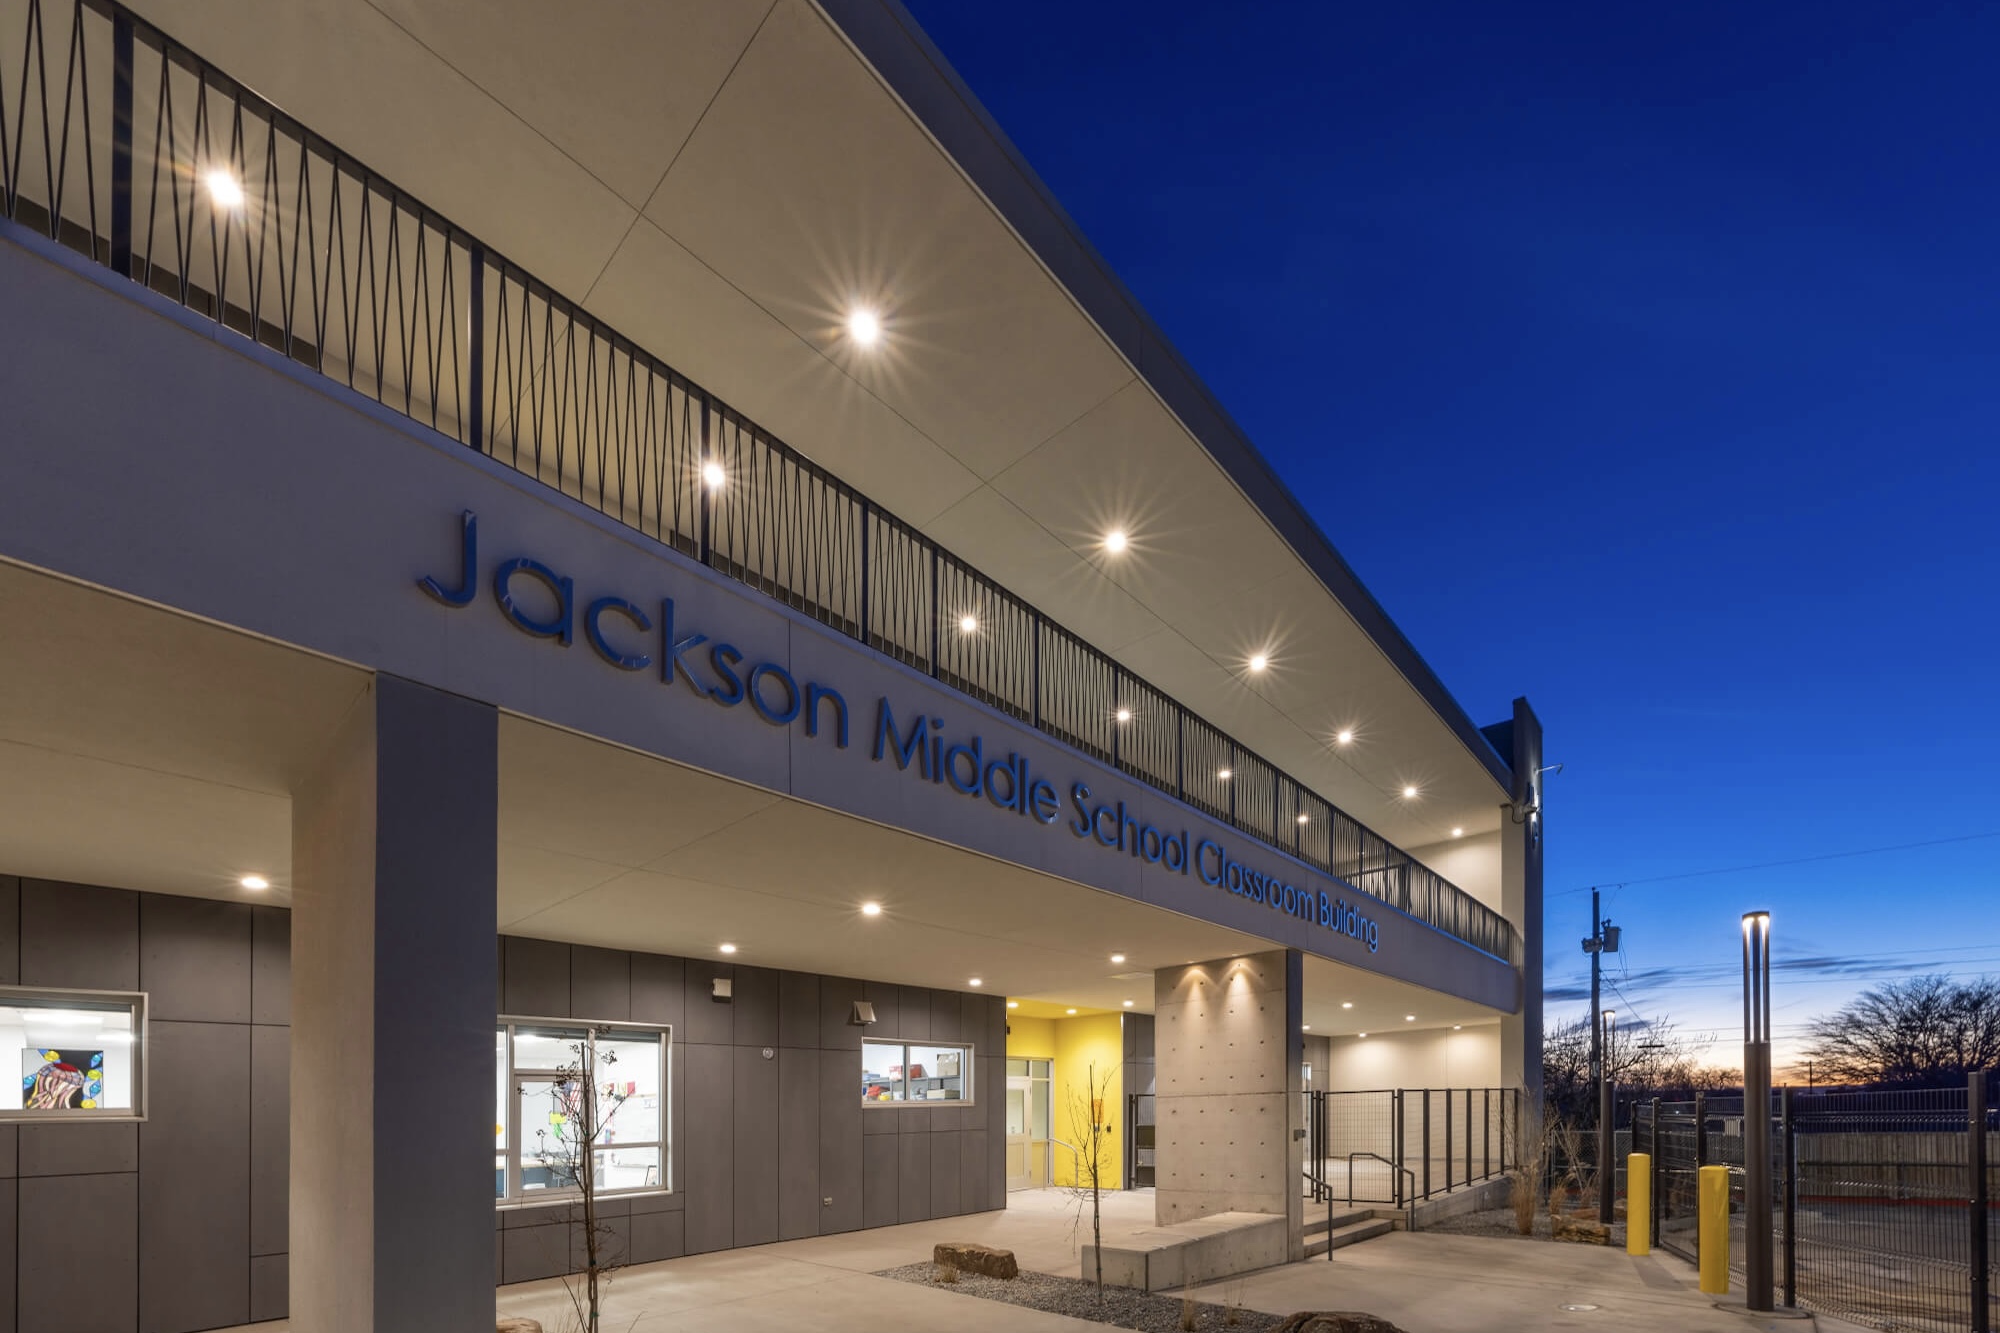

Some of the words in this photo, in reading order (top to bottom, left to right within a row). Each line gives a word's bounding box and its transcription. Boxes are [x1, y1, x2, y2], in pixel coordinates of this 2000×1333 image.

[418, 509, 849, 749] Jackson
[872, 697, 1060, 823] Middle
[1070, 785, 1192, 874] School
[1198, 839, 1316, 920] Classroom
[1319, 892, 1379, 953] Building
